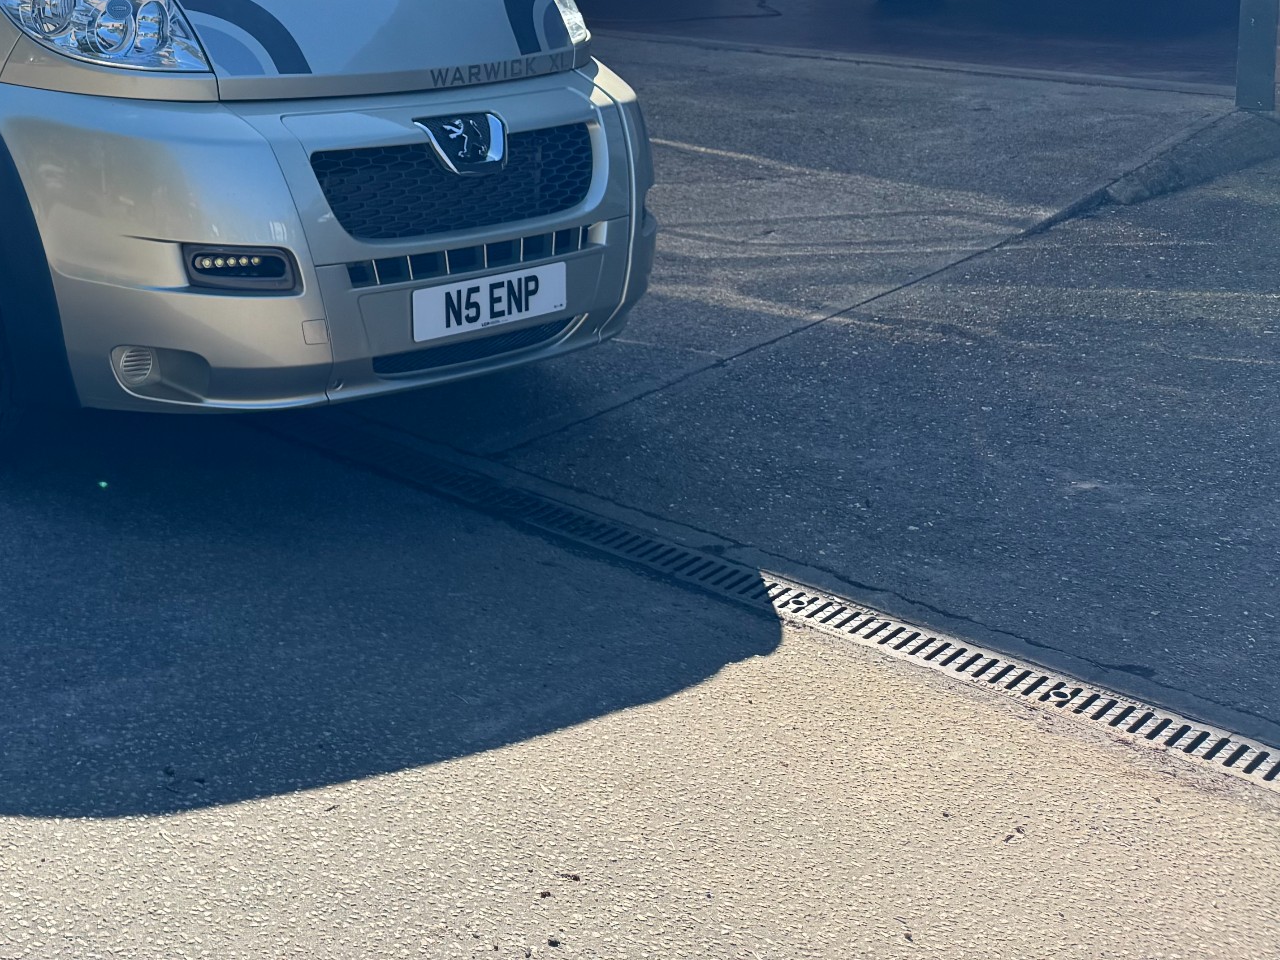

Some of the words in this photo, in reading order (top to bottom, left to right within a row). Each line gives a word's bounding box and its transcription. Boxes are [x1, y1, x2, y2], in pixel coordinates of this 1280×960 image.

[430, 57, 538, 87] WARWICK
[445, 286, 481, 328] N5
[489, 274, 539, 319] ENP
